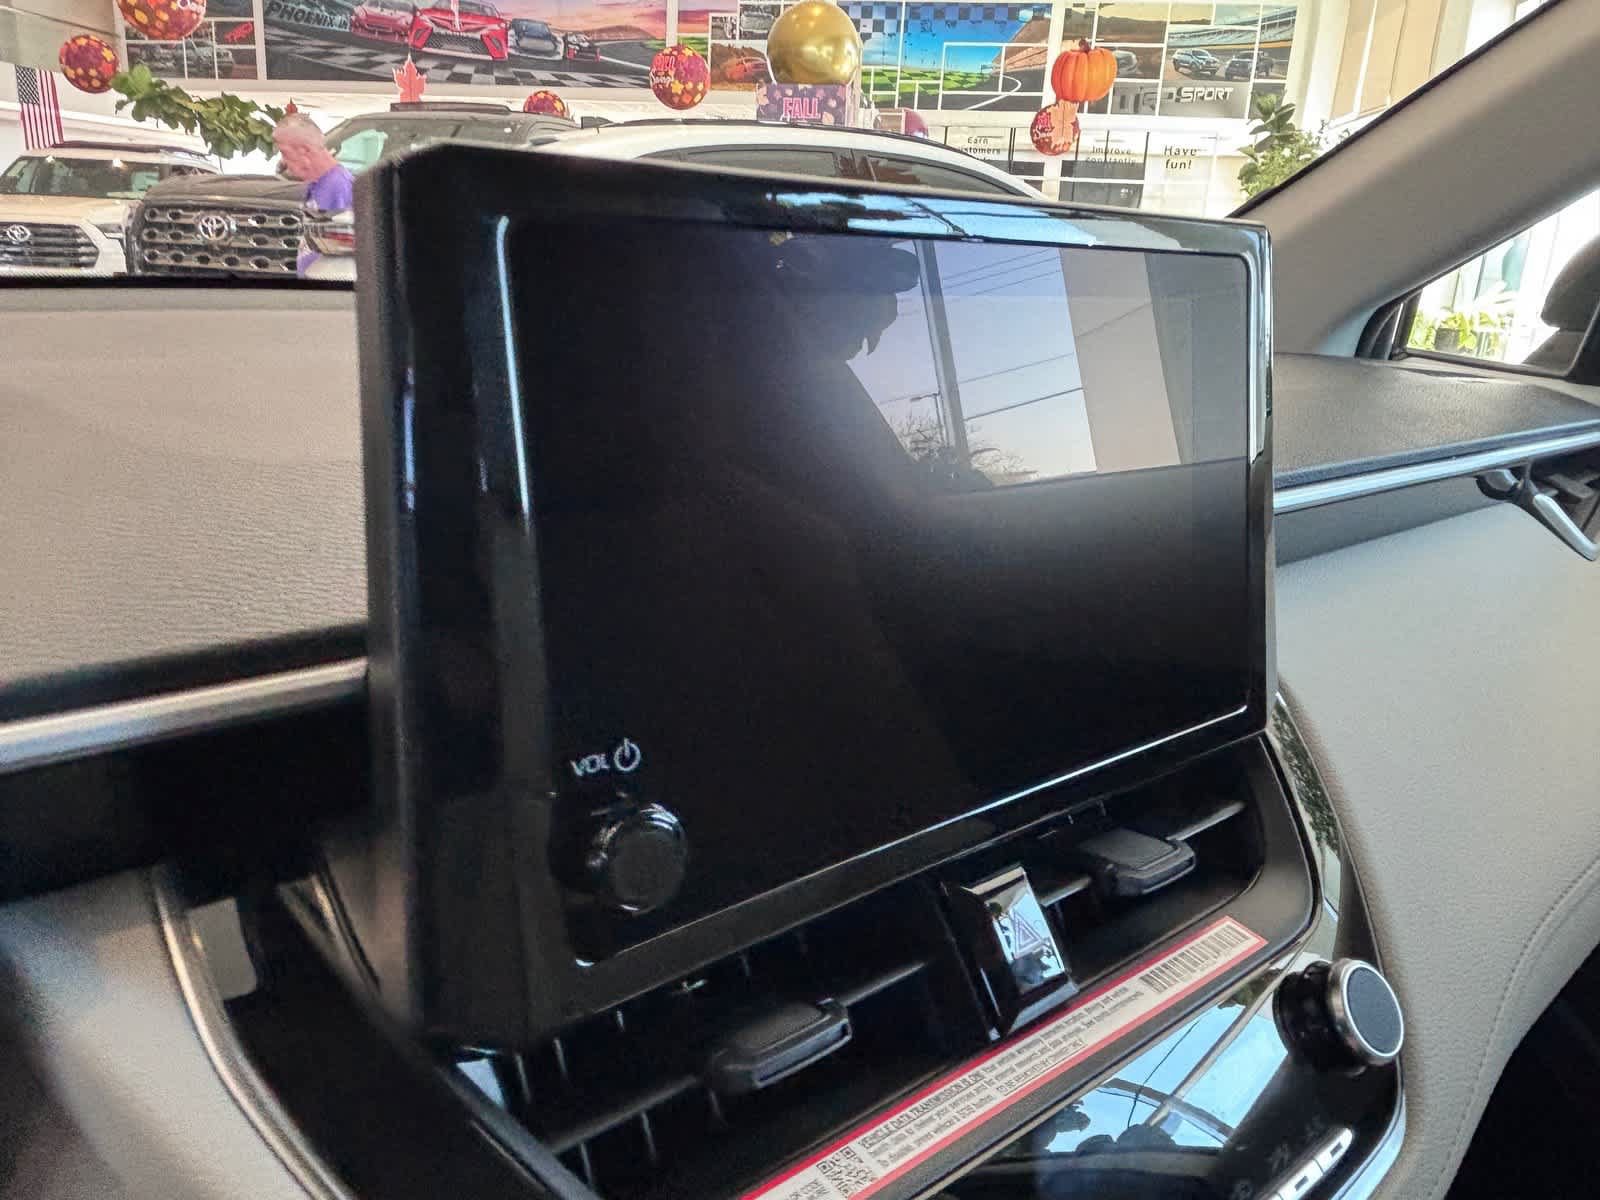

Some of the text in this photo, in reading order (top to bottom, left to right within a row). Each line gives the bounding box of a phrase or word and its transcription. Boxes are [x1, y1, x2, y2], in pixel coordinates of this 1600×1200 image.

[265, 0, 334, 28] PHOENIX
[1179, 87, 1234, 103] SPORT
[782, 97, 820, 119] FALL
[968, 137, 989, 145] Earn
[1163, 145, 1198, 157] Have
[1165, 159, 1193, 170] fun!
[570, 753, 610, 776] VOL
